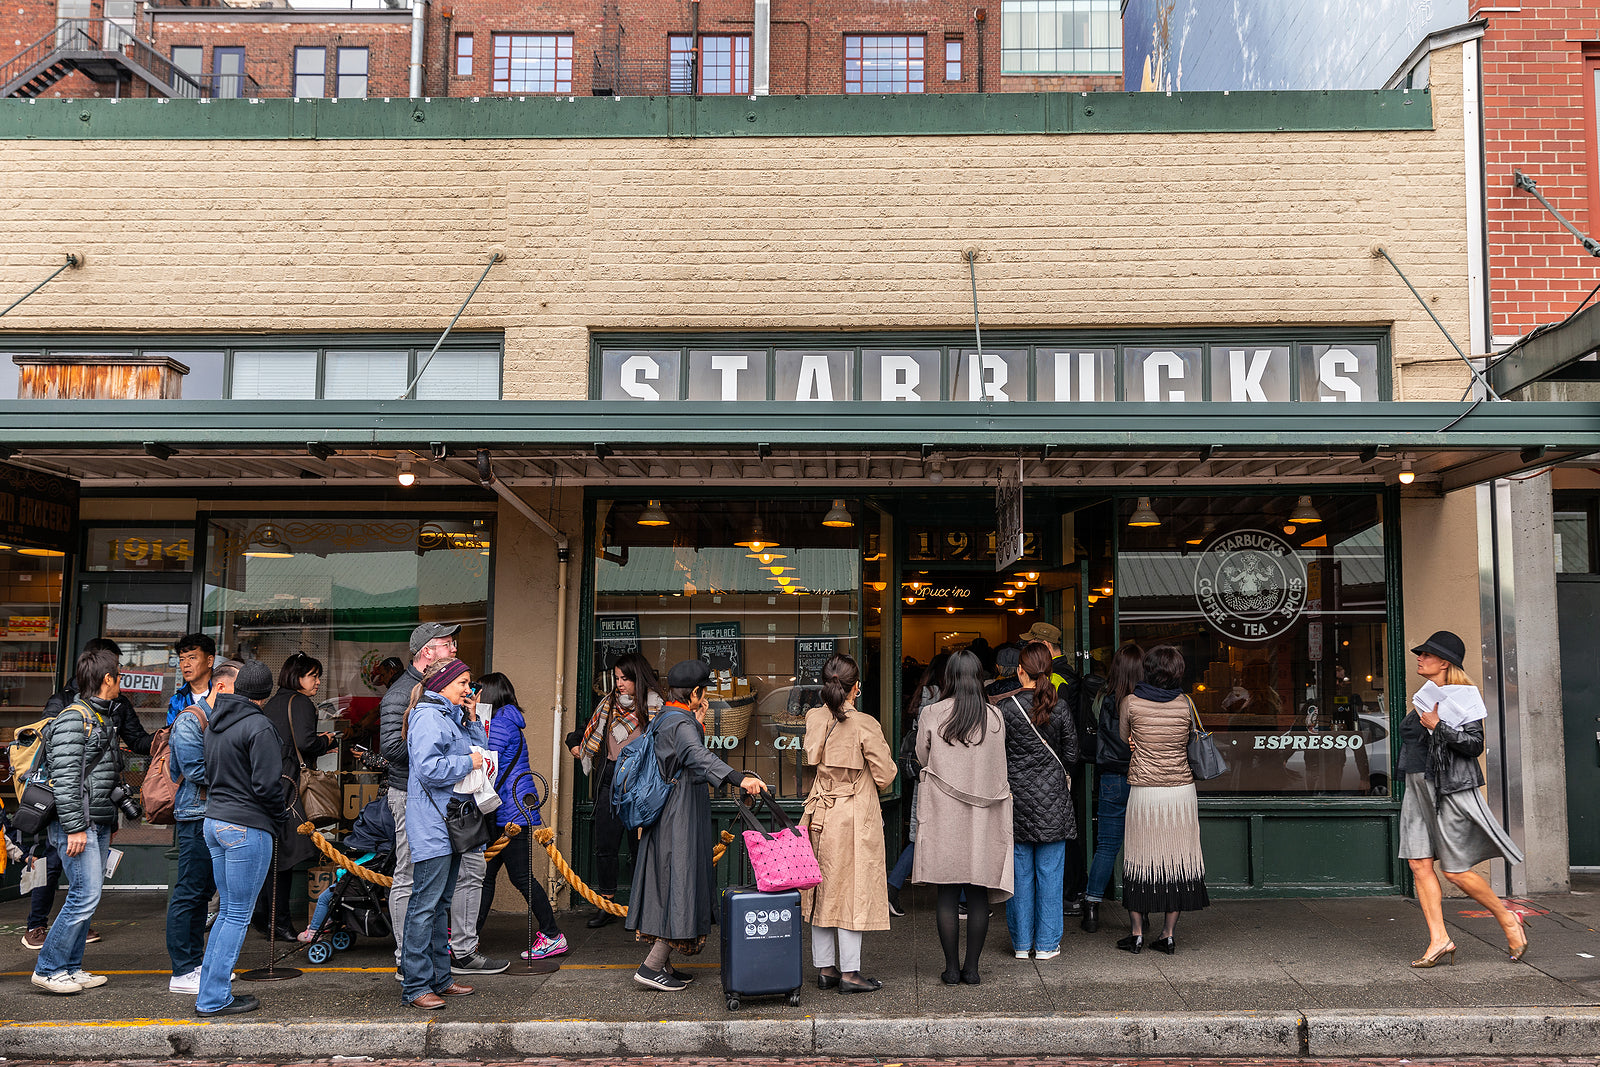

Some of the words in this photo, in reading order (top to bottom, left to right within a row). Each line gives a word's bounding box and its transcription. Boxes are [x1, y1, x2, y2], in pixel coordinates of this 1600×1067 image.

[620, 349, 1361, 402] STARBUCKS
[107, 537, 194, 561] 1914
[1214, 534, 1286, 557] STARBUCKS
[1199, 578, 1228, 625] COFFEE
[1243, 623, 1268, 636] TEA
[1280, 577, 1302, 619] SPICES
[601, 621, 615, 631] PIKE
[616, 620, 635, 630] PLACE
[716, 628, 735, 638] PLACE
[800, 642, 813, 651] PIKE
[814, 641, 833, 651] PLACE
[123, 674, 159, 690] OPEN
[773, 736, 804, 750] CA
[1253, 735, 1363, 750] ESPRESSO
